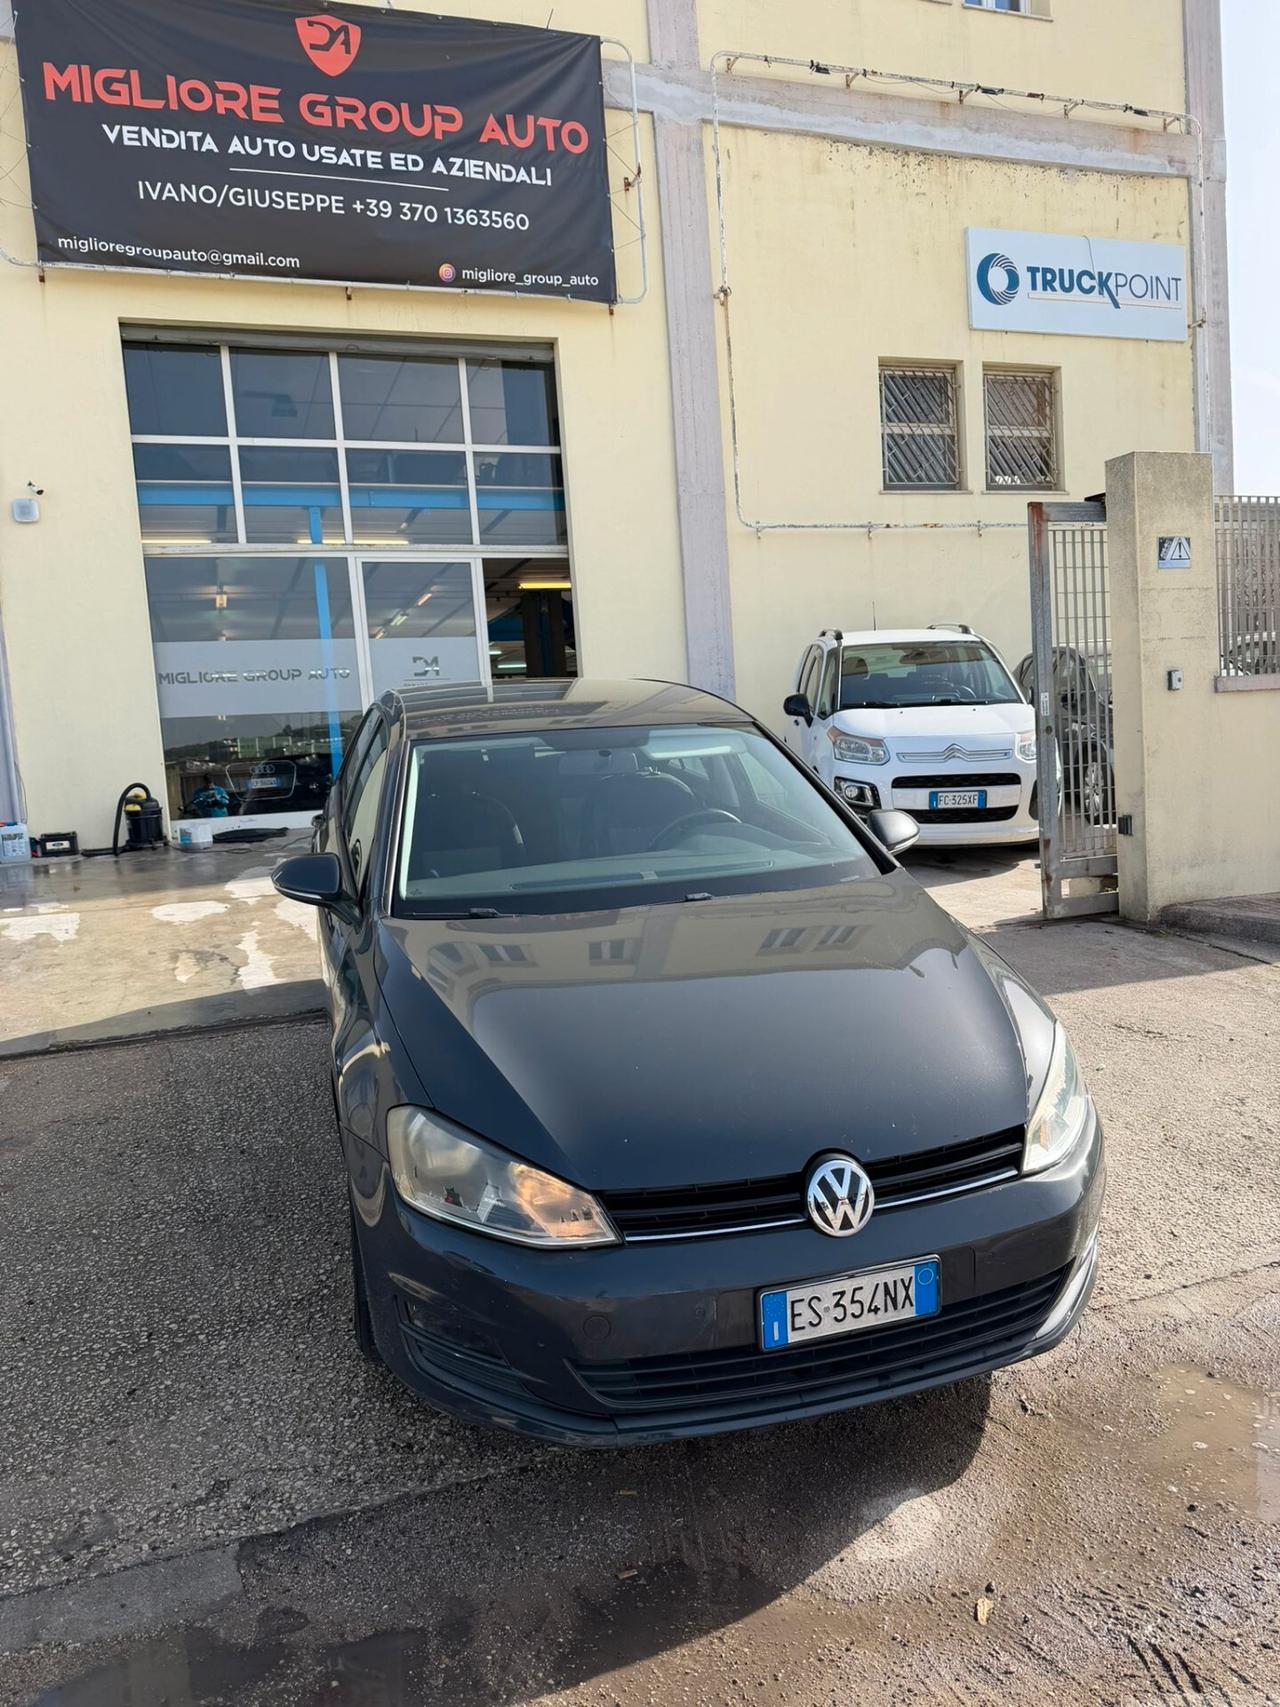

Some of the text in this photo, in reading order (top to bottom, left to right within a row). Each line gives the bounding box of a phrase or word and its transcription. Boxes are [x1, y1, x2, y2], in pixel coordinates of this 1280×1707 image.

[42, 62, 589, 155] MIGLIORE GROUP AUTO
[102, 124, 552, 186] VENDITA AUTO USATE ED AZIENDALI
[138, 181, 530, 231] IVANO/GIUSEPPE +39 370 1363560
[58, 237, 300, 268] miglioregroupauto@gmail.com
[462, 267, 599, 287] migliore_group_auto
[158, 667, 350, 685] MIGLIORE GROUP AUTO
